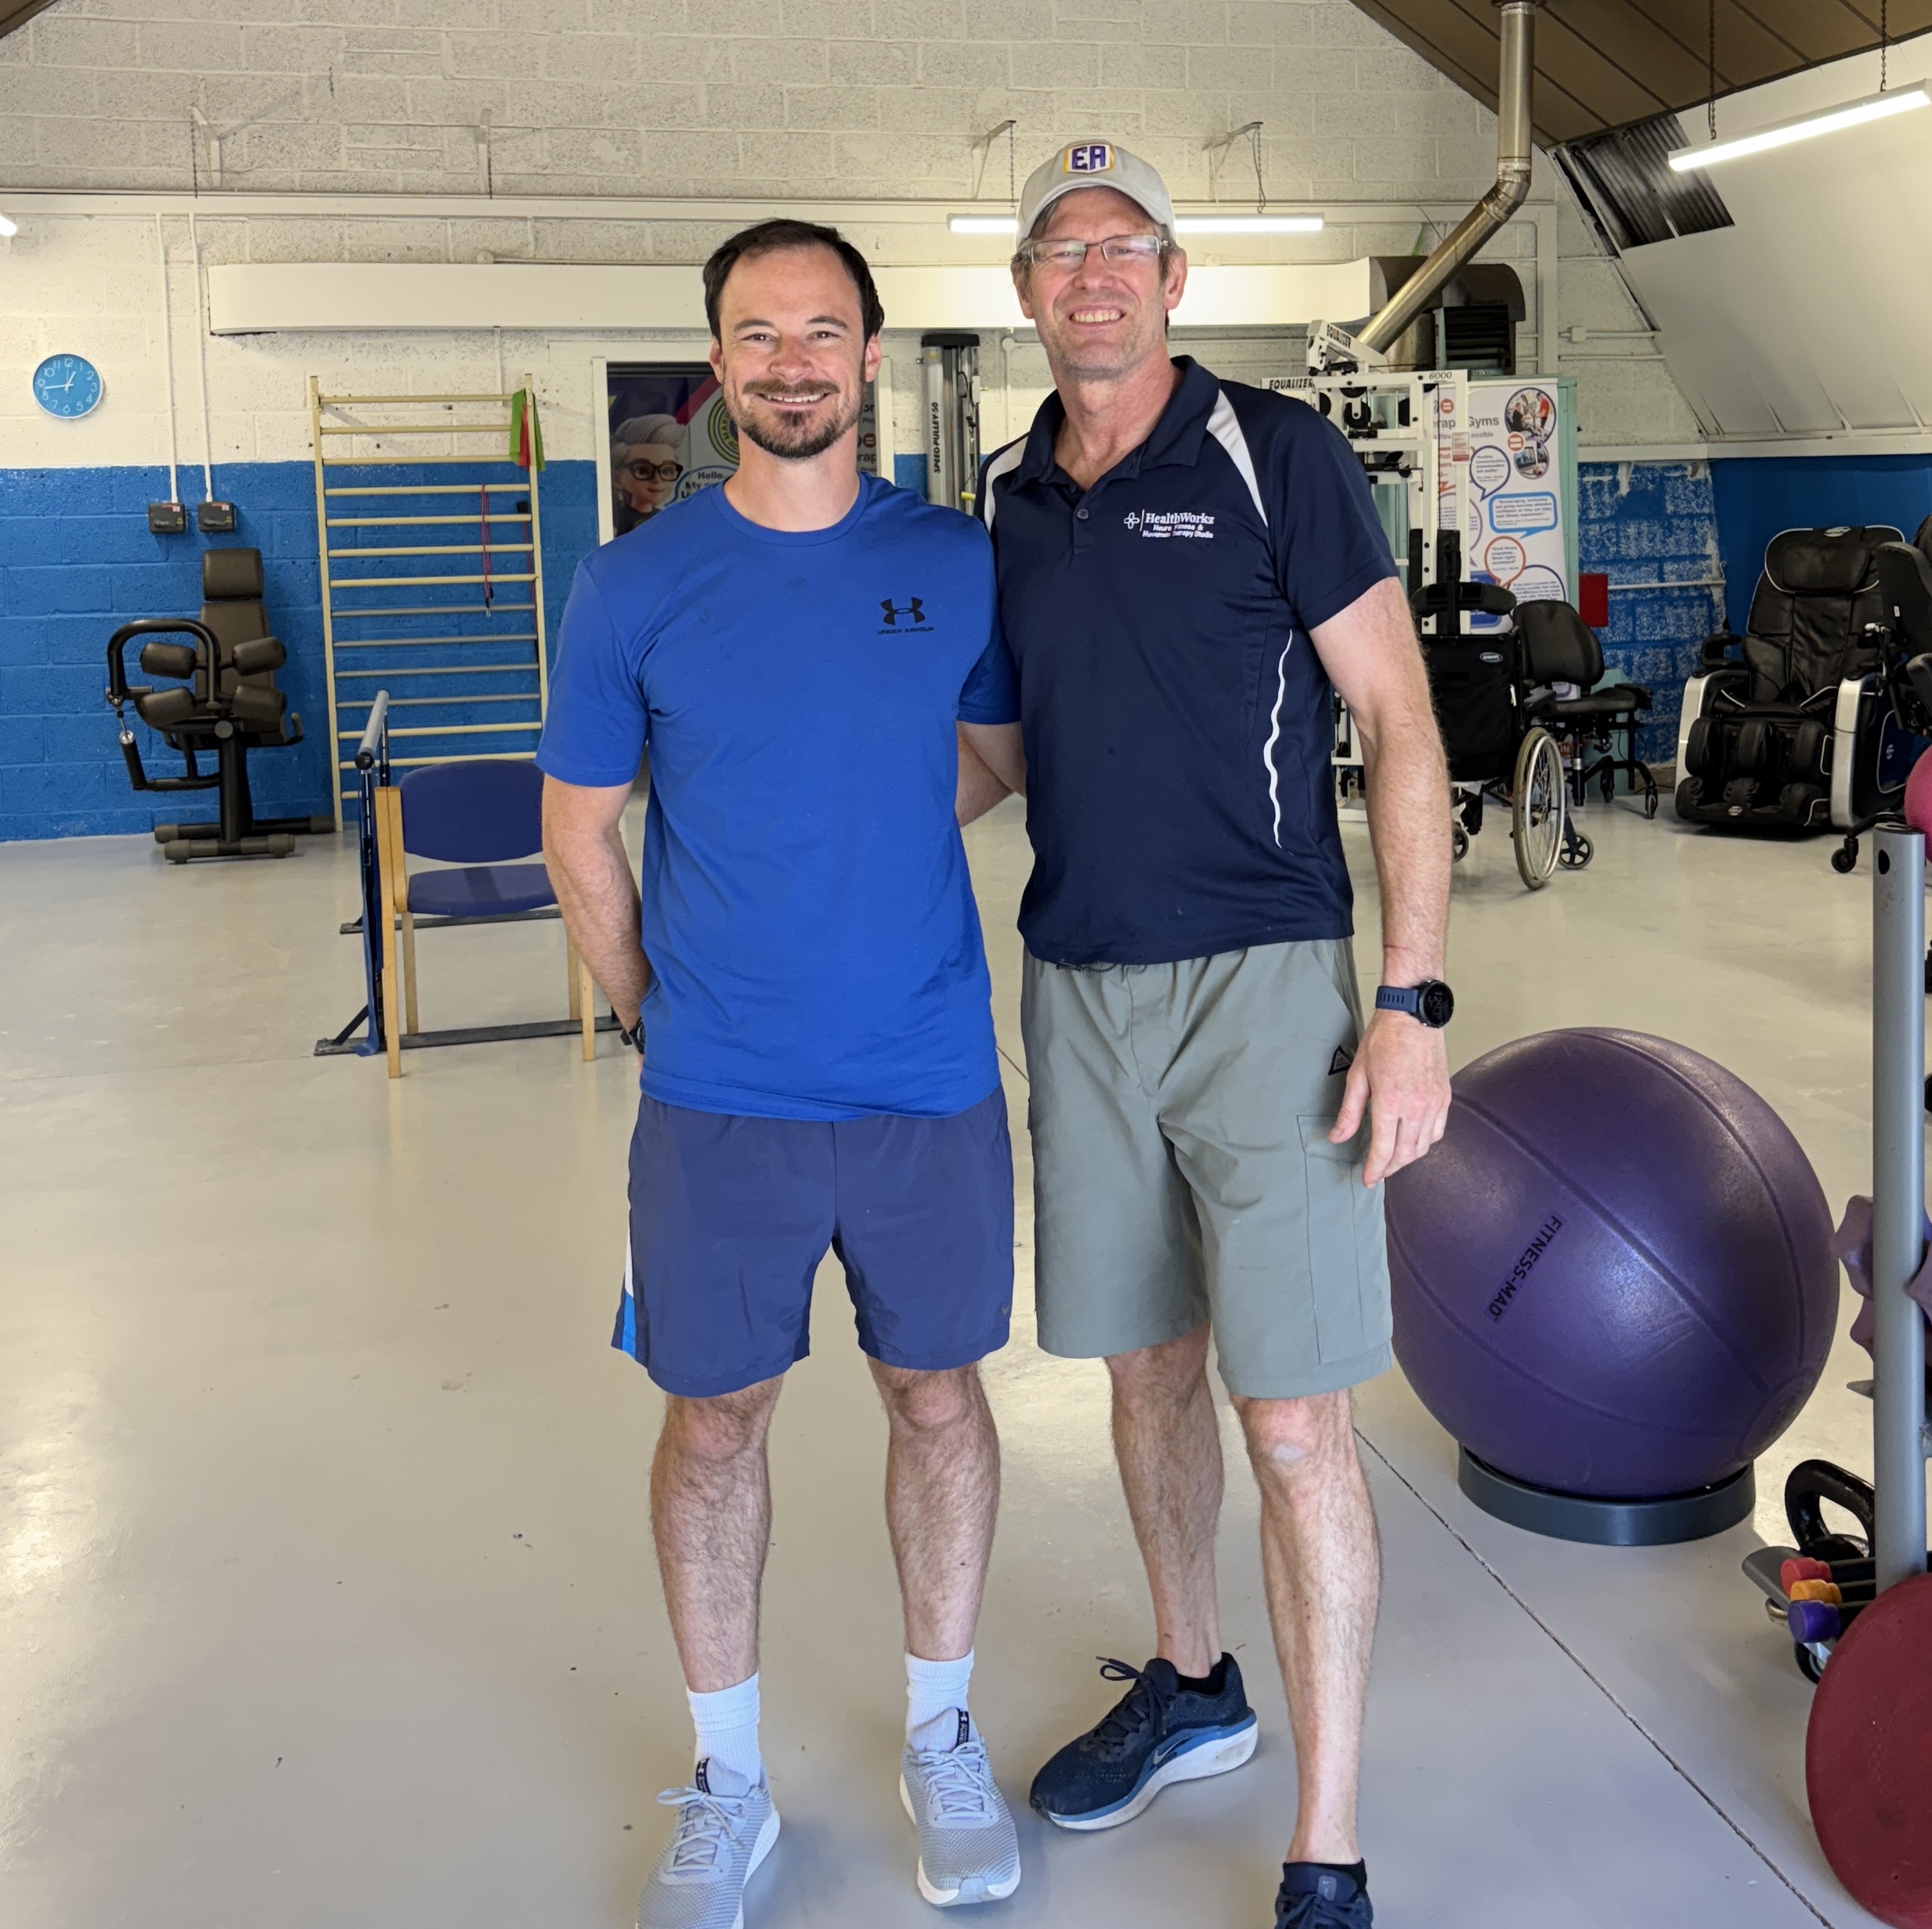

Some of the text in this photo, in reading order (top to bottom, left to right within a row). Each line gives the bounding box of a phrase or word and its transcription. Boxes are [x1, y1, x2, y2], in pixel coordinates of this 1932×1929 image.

[1071, 145, 1107, 171] EA
[1327, 323, 1352, 349] EQUALIZER
[53, 360, 60, 370] 11
[64, 357, 74, 367] 12
[44, 367, 55, 377] 10
[87, 371, 94, 381] 2
[1428, 371, 1453, 380] 6000
[91, 382, 98, 392] 3
[42, 391, 49, 400] 8
[85, 394, 92, 403] 4
[52, 399, 59, 409] 7
[63, 404, 70, 414] 6
[76, 401, 84, 411] 5
[1490, 1216, 1563, 1317] FITNESS-MAD
